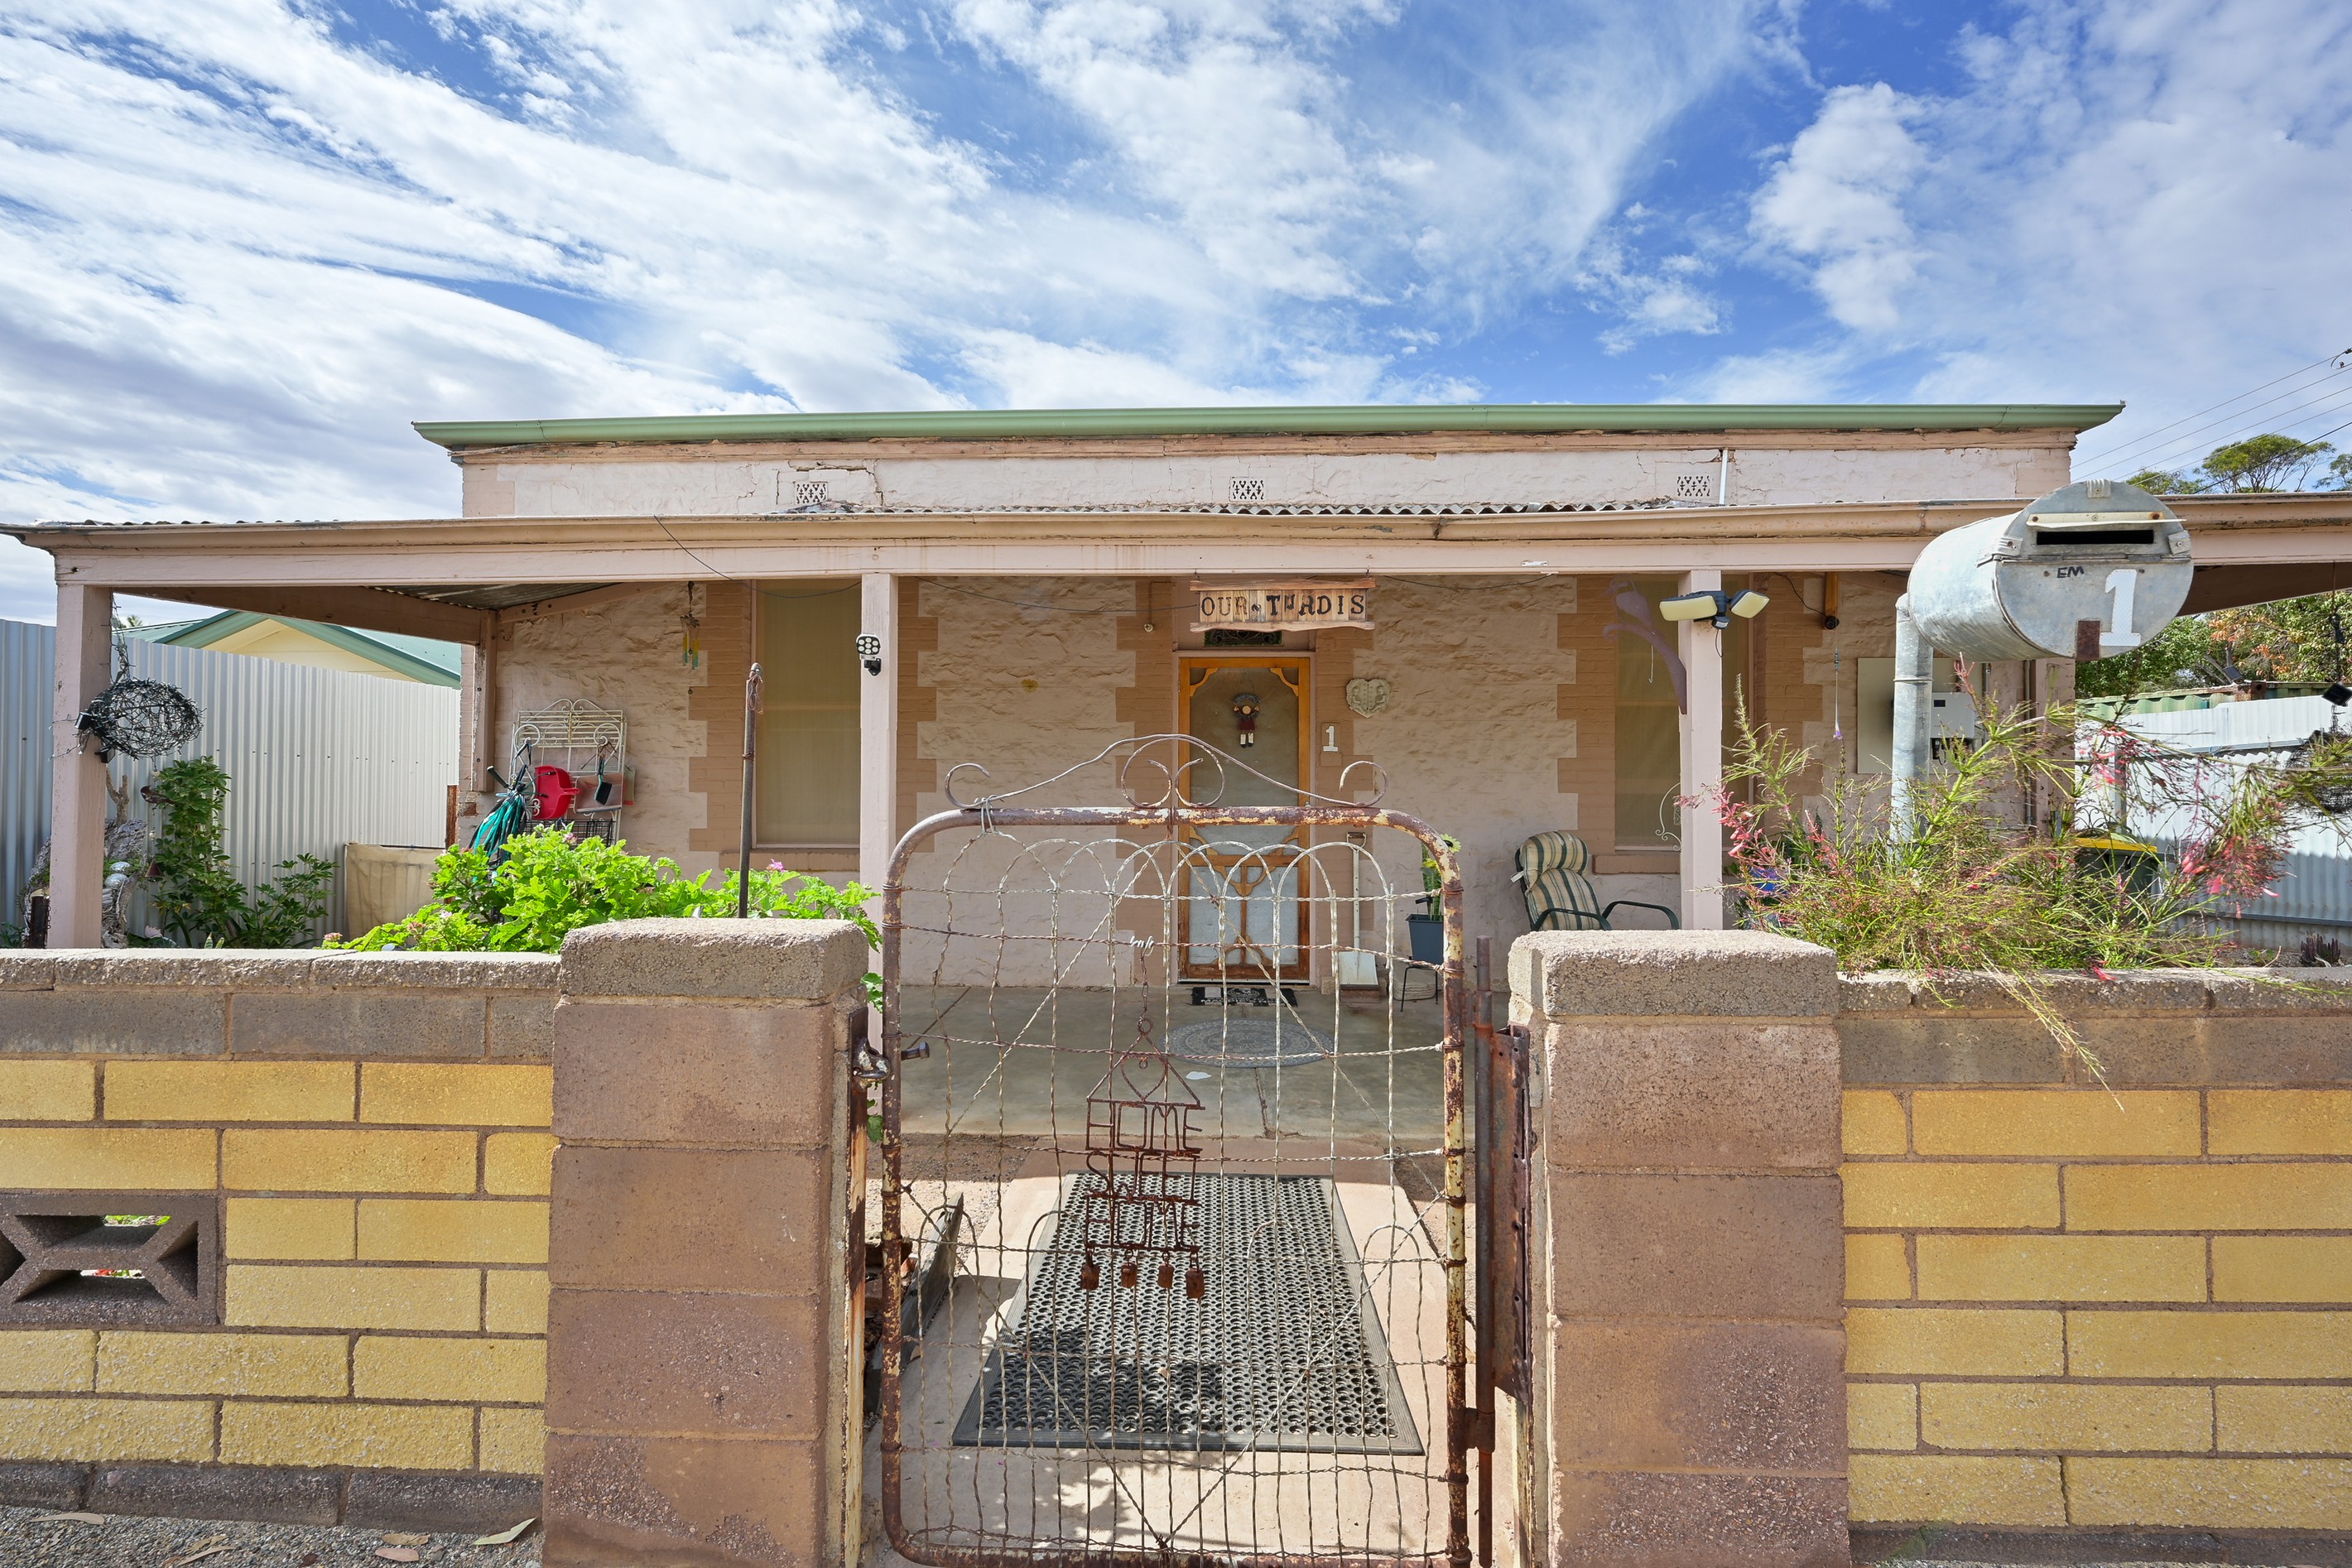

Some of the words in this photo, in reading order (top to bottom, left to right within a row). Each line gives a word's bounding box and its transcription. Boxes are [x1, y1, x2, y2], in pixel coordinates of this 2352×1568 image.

[2056, 565, 2085, 579] EM
[1201, 596, 1248, 616] OUR
[2099, 569, 2141, 646] 1
[1323, 725, 1338, 752] 1
[1085, 1099, 1205, 1155] HOME
[1085, 1195, 1201, 1253] HOME
